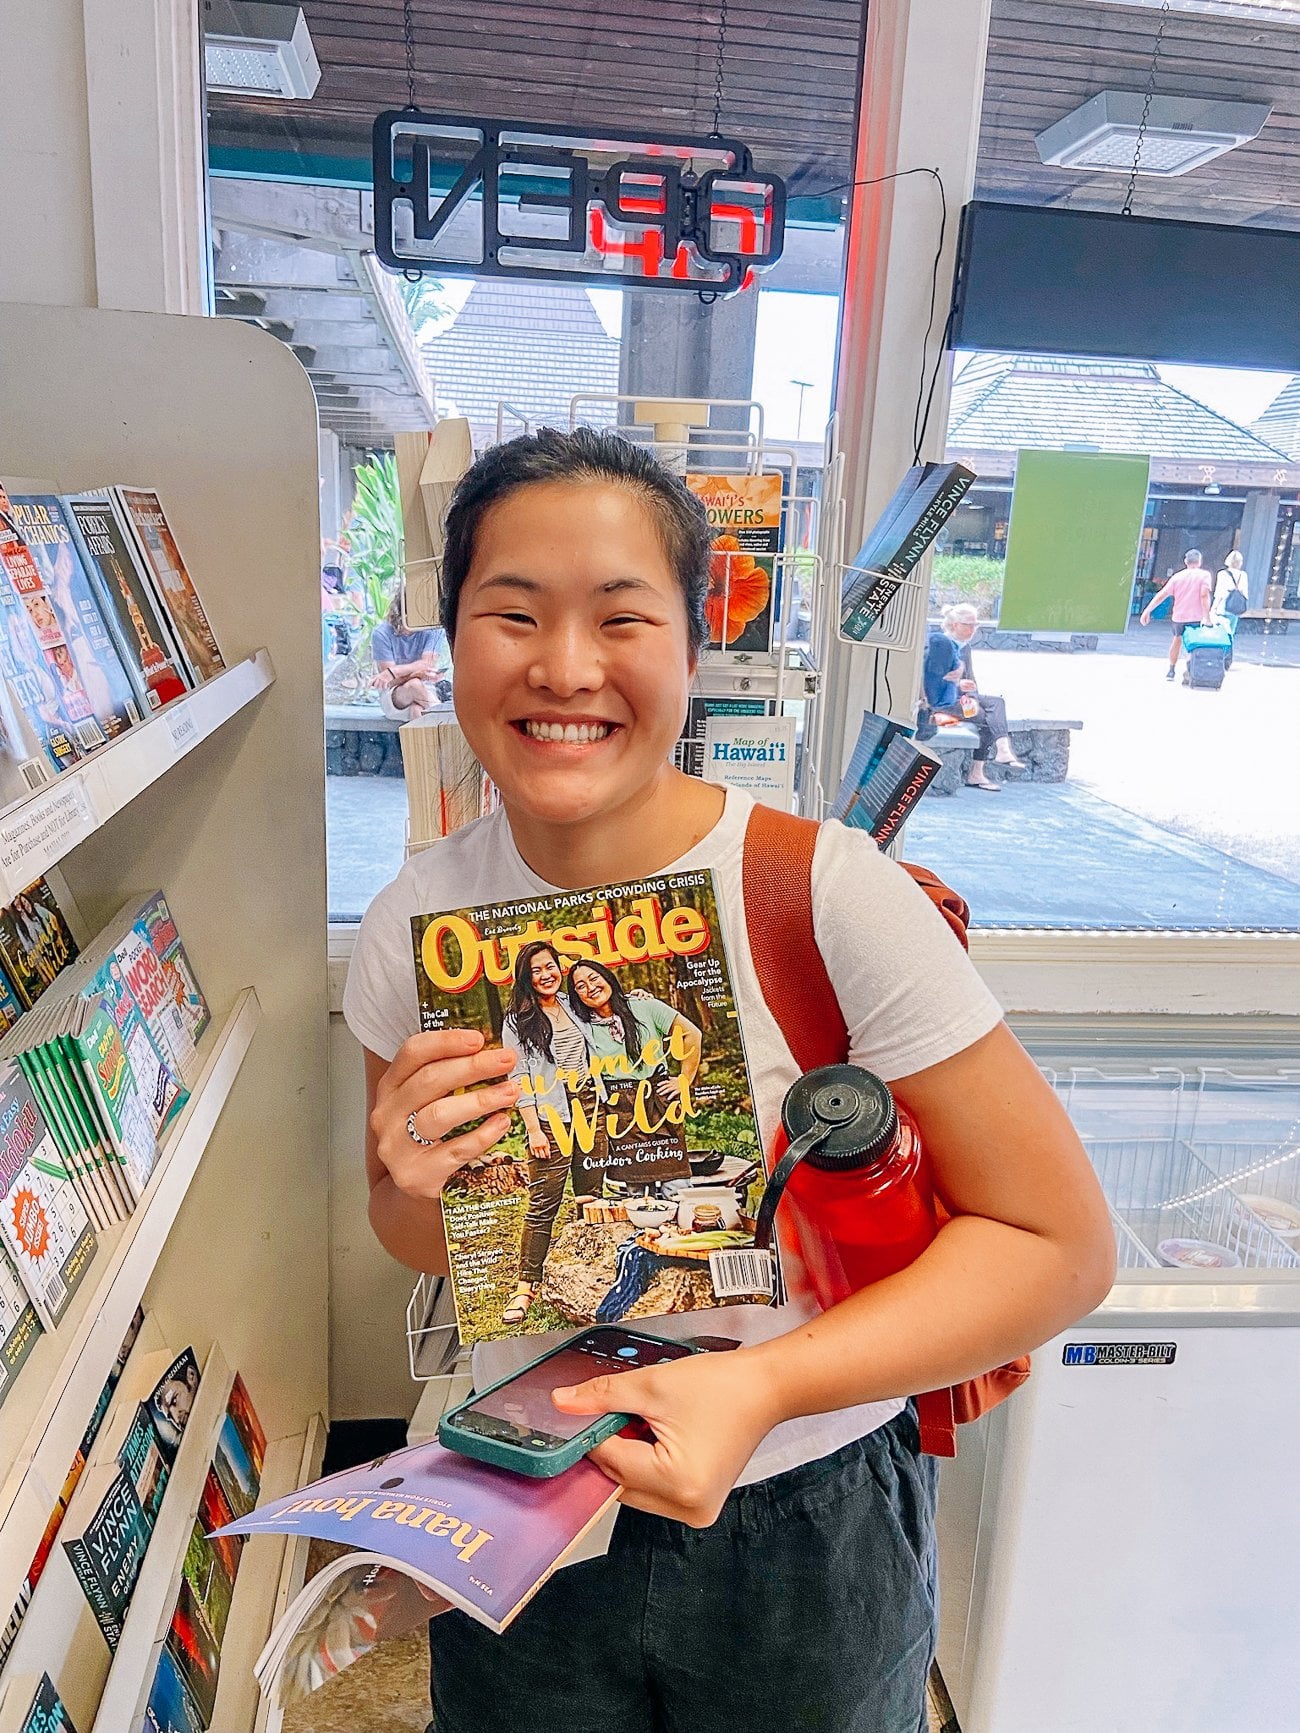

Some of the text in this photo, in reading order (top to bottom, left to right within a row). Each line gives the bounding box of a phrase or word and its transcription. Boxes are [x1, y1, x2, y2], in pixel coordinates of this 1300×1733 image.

[13, 504, 51, 527] PULAR
[706, 508, 764, 525] OWERS
[904, 477, 970, 564] VINCE FLYNN
[22, 524, 70, 546] CHANICS
[87, 535, 116, 557] AFFAIRS
[16, 578, 36, 592] LIVES
[859, 578, 890, 618] STATE
[874, 583, 897, 615] ENEMY
[733, 738, 769, 748] Map of
[756, 775, 772, 783] Maps
[874, 763, 933, 844] VINCE FLYNN
[10, 847, 20, 863] for
[18, 836, 42, 857] Purchase
[468, 873, 706, 923] THE NATIONAL PARKS CROWDING CRISIS
[421, 896, 711, 994] Outside
[126, 947, 158, 997] WORD
[686, 958, 720, 970] Gear Up
[693, 967, 722, 978] for the
[676, 976, 723, 990] Apocalypse
[702, 985, 725, 995] Jackets
[421, 1008, 449, 1020] The Call
[707, 1000, 728, 1009] Future
[423, 1018, 444, 1029] of the
[519, 1024, 697, 1096] urmet
[610, 1081, 634, 1091] IN THE
[4, 1097, 20, 1130] Easy
[537, 1073, 702, 1159] Wild
[651, 1139, 670, 1147] GUIDE
[582, 1146, 684, 1171] Outdoor Cooking
[464, 1203, 480, 1212] THE
[23, 1198, 40, 1251] JUMBO
[451, 1231, 465, 1240] You
[481, 1256, 498, 1264] Wild
[1064, 1343, 1175, 1364] MB MASTER-BILT
[164, 1354, 189, 1386] GRISHAM
[126, 1421, 145, 1466] JAMES
[129, 1422, 156, 1487] ATTERSON
[92, 1482, 132, 1555] VINCE
[270, 1496, 495, 1564] hana hou!
[101, 1500, 139, 1576] FLYNN
[72, 1543, 110, 1609] VINCE FLYNN
[111, 1535, 138, 1598] ENEMY
[111, 1623, 121, 1638] ENE
